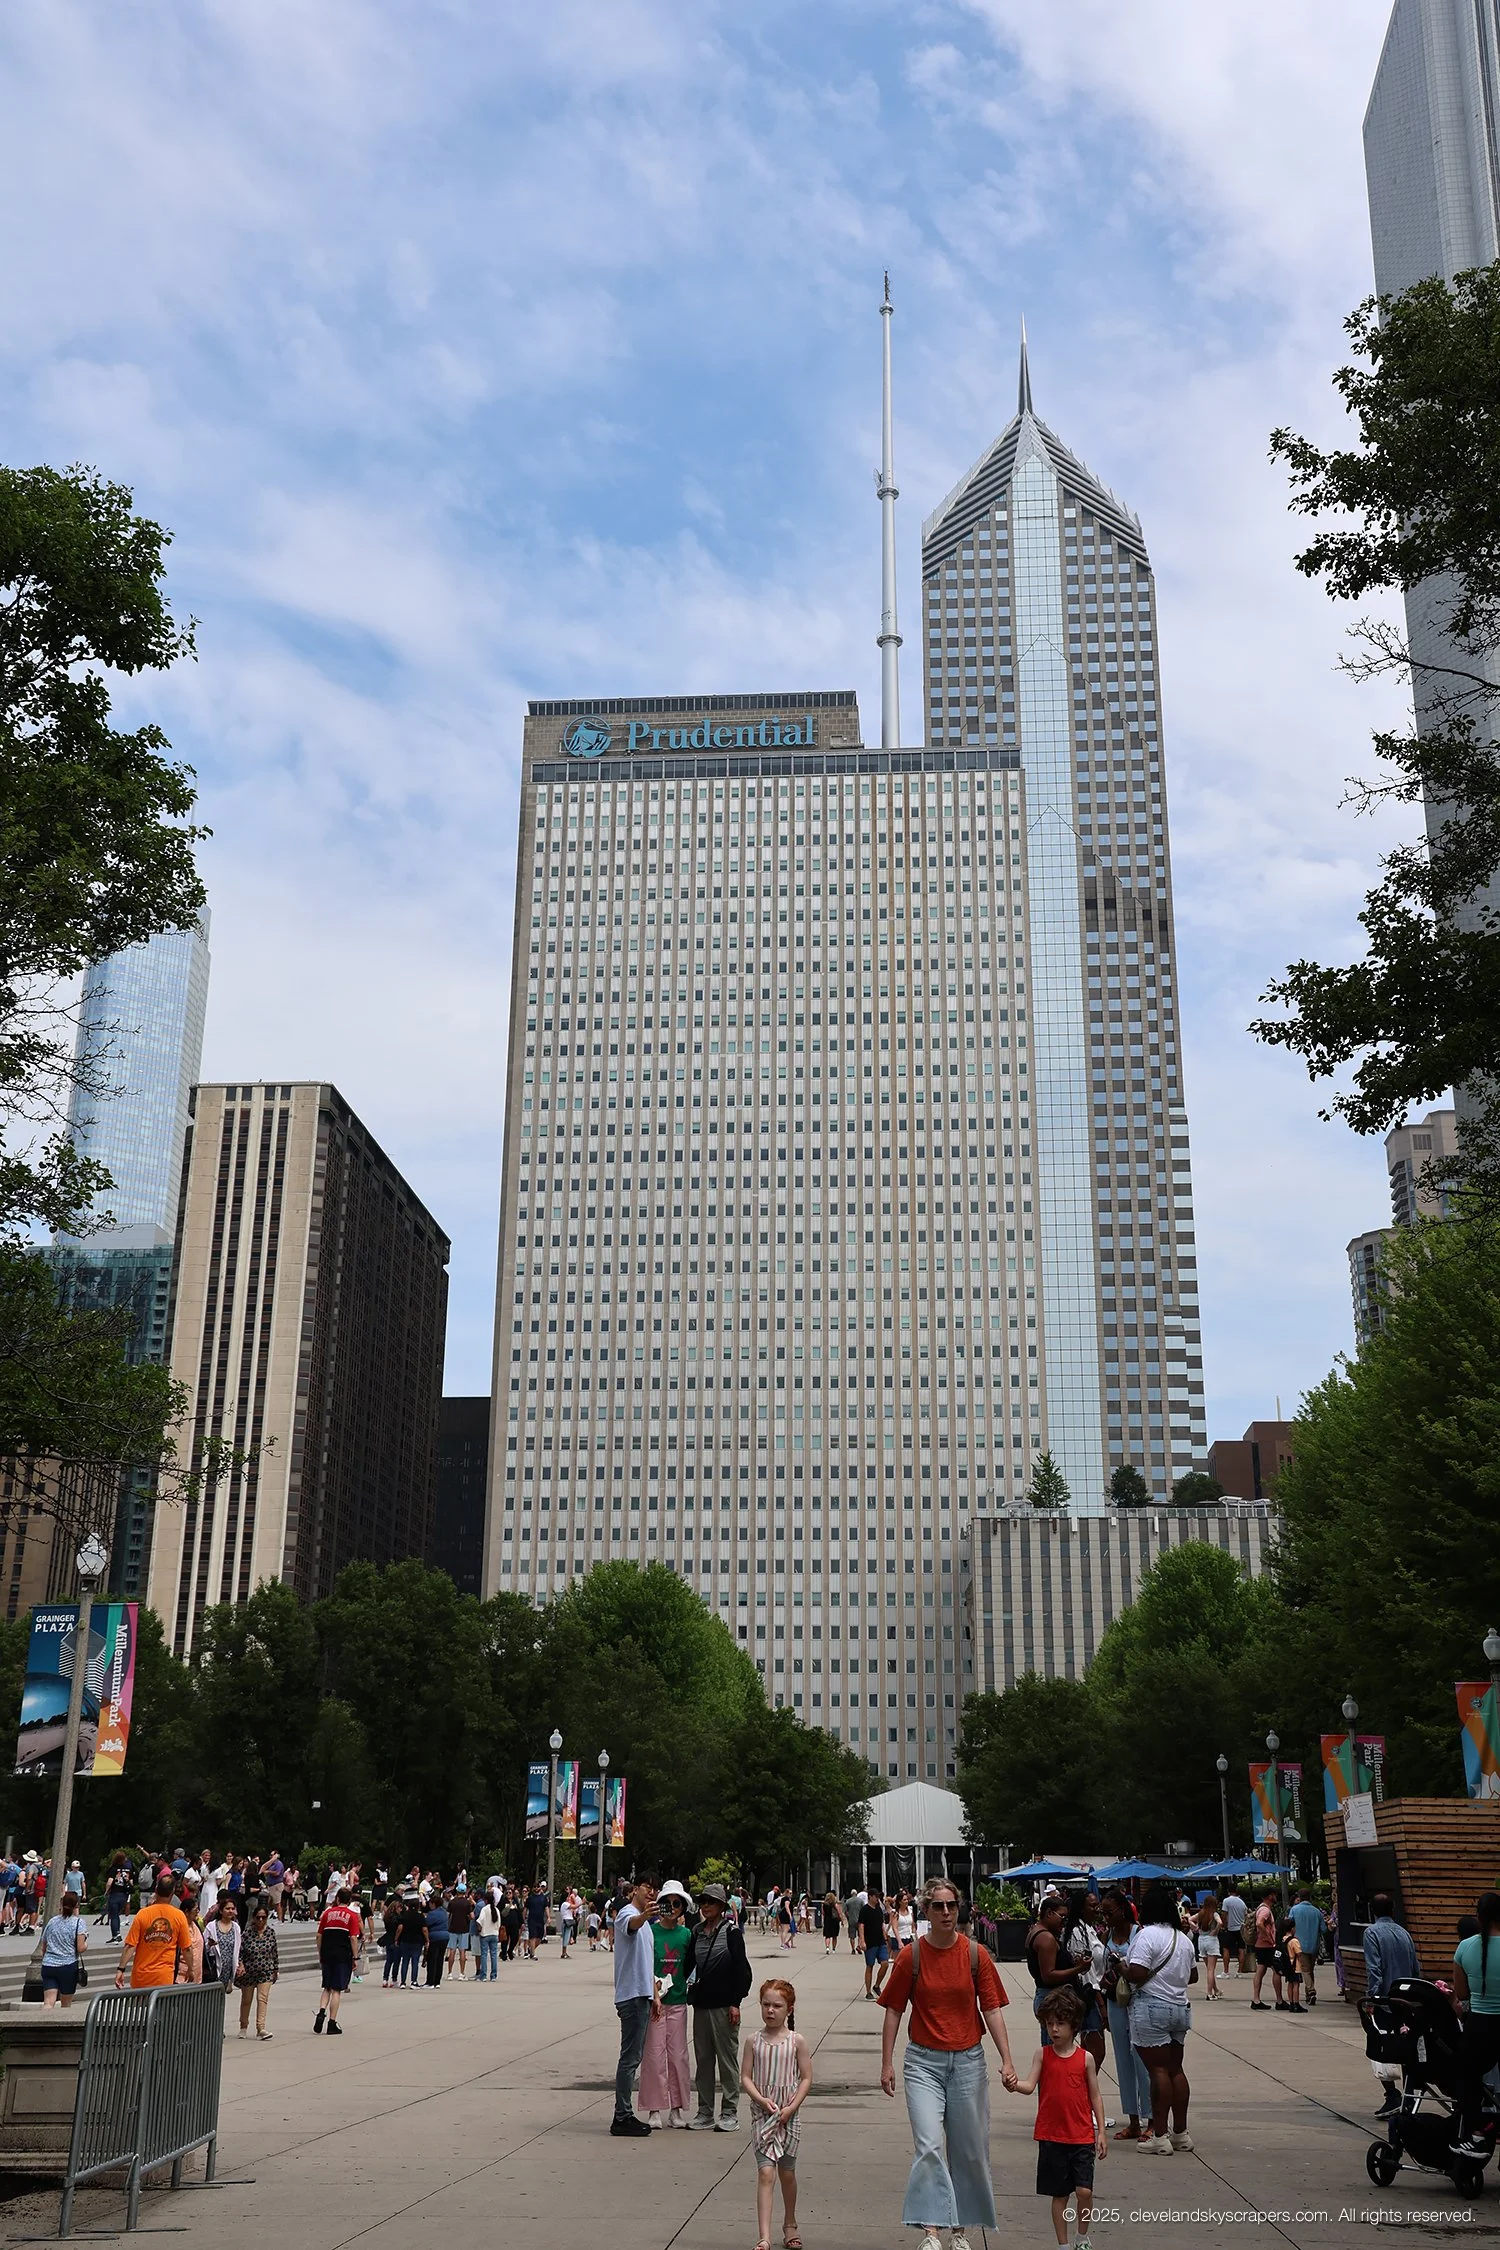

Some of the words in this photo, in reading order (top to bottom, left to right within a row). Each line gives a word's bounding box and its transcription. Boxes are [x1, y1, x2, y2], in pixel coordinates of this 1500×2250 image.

[626, 715, 817, 751] Prudential
[34, 1623, 75, 1633] PLAZA
[35, 1615, 75, 1623] GRAINGER
[1363, 1742, 1374, 1766] Park
[1283, 1769, 1293, 1789] Park
[1373, 1743, 1385, 1802] Millennium
[1292, 1770, 1301, 1819] Millennium
